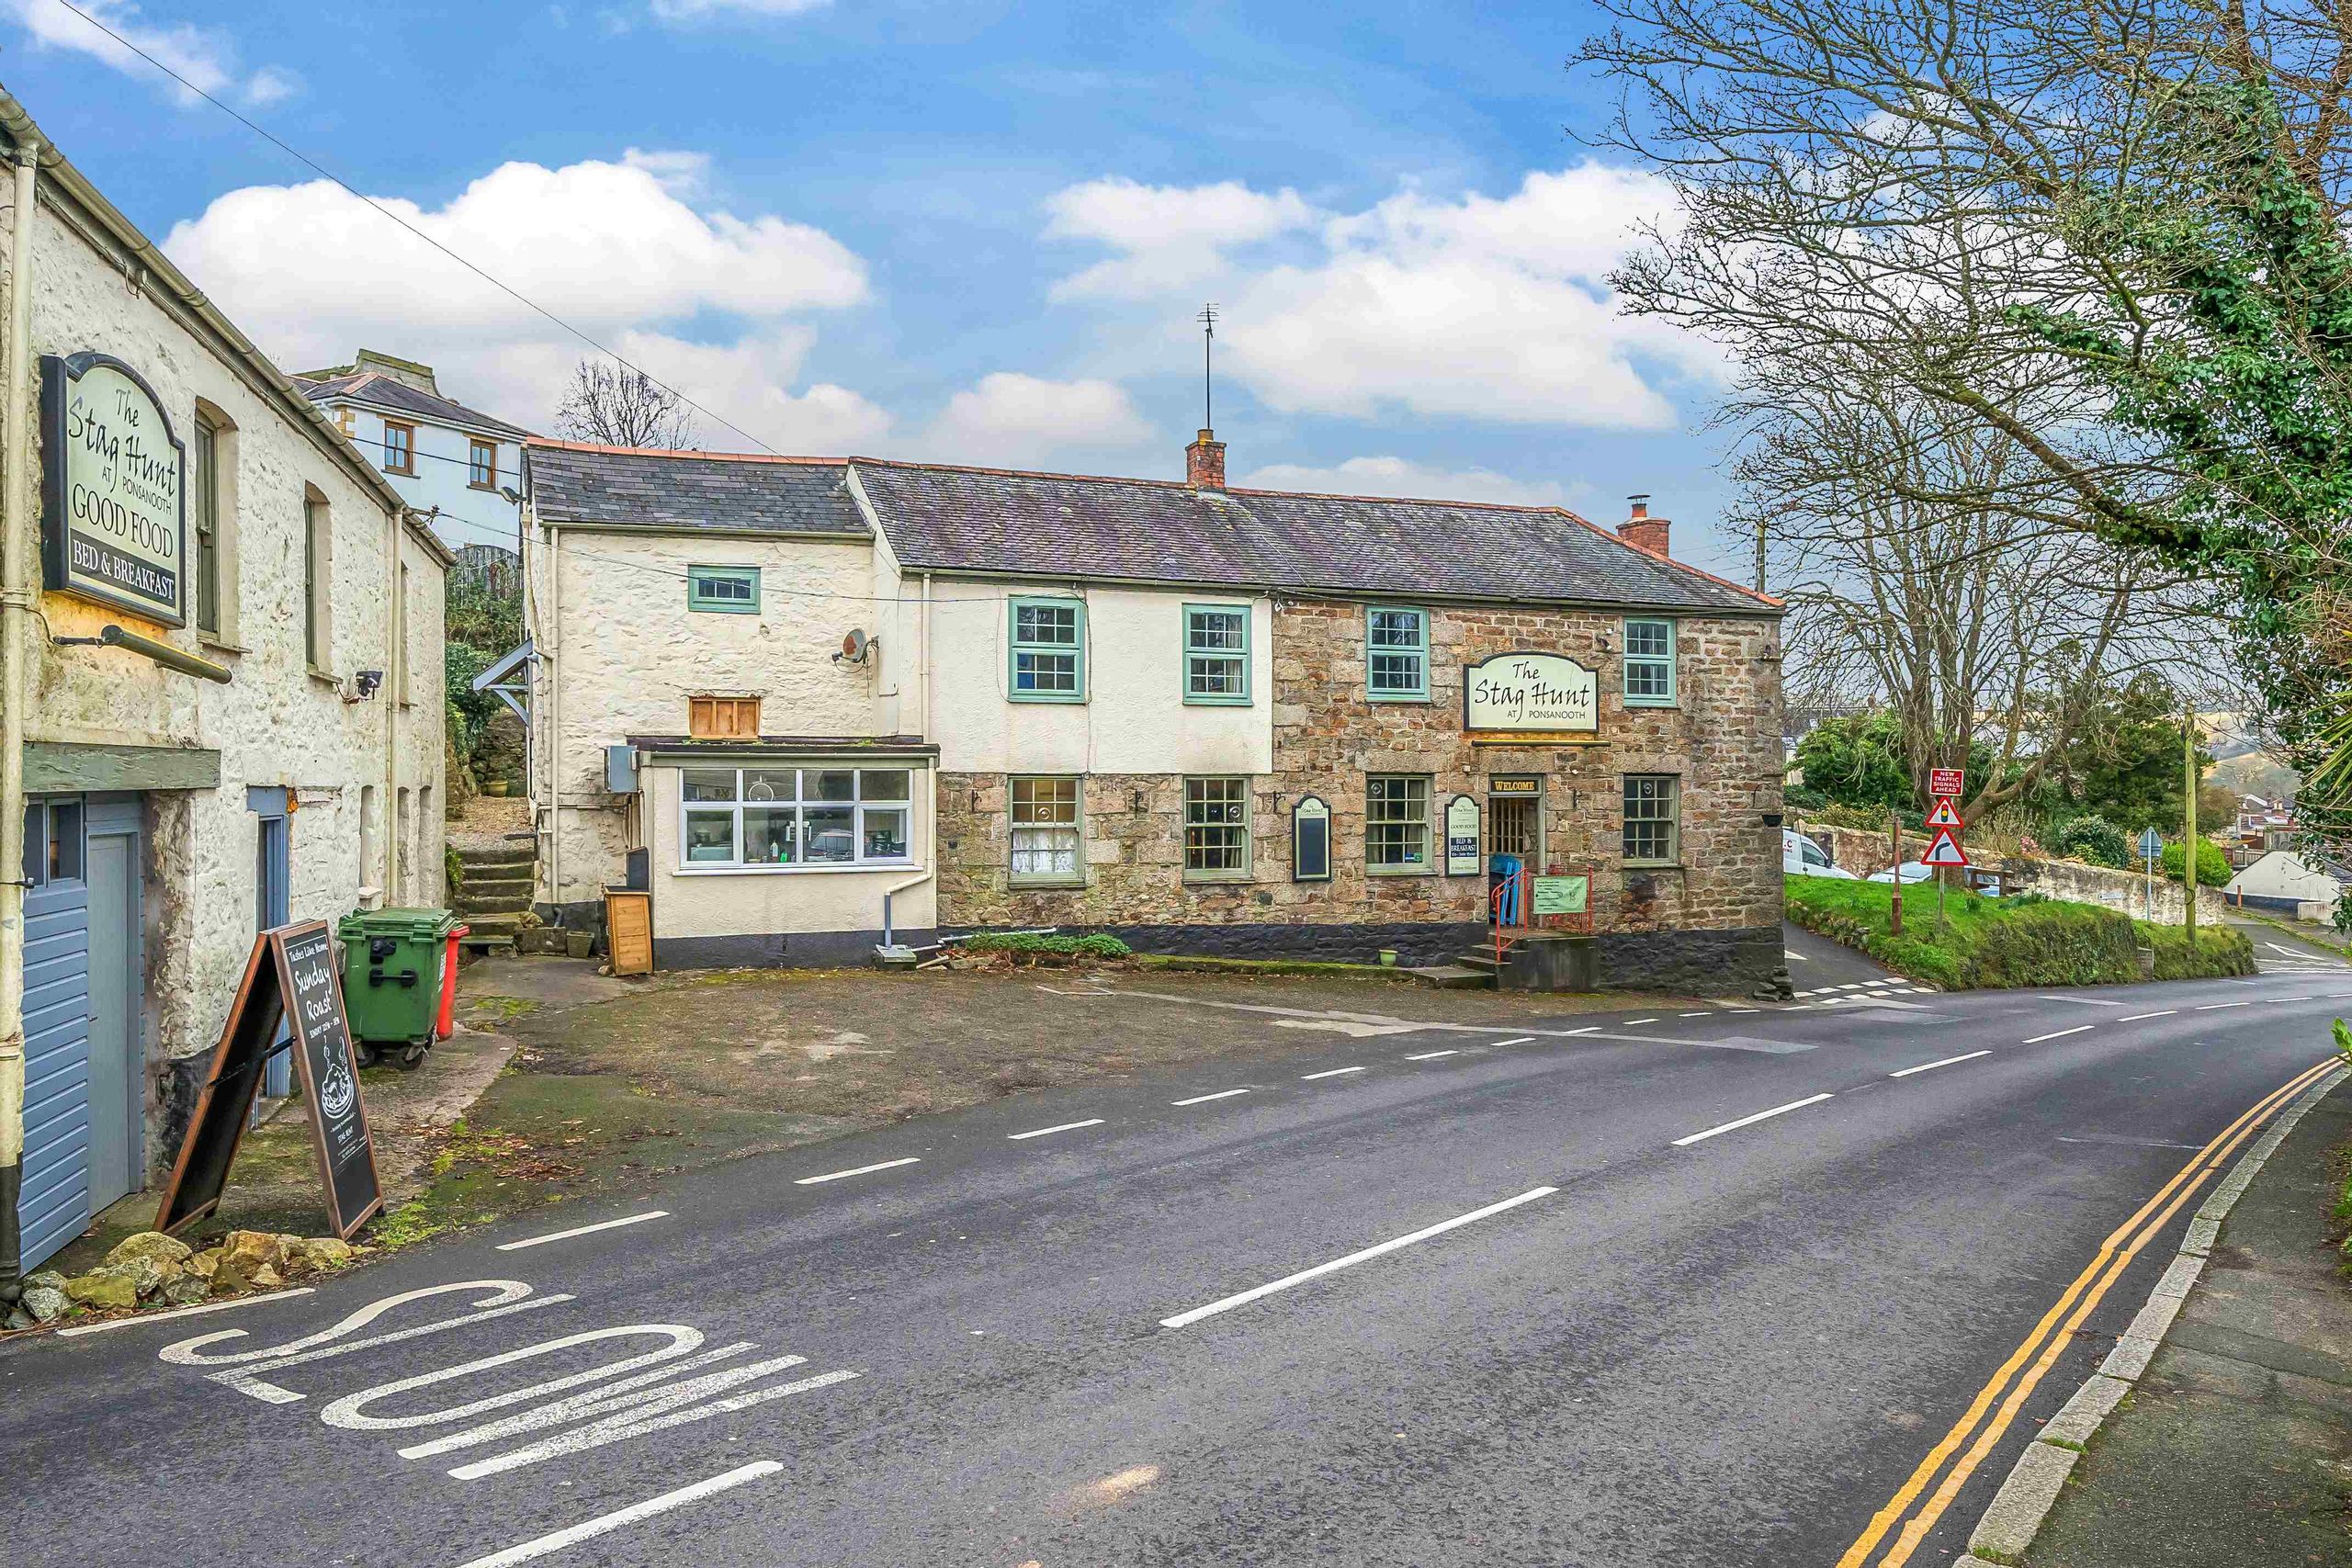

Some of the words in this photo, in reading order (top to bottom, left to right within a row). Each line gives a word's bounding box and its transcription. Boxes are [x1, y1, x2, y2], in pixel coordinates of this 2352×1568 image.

[116, 389, 140, 427] The
[69, 396, 119, 493] Stag
[126, 434, 176, 498] Hunt
[102, 465, 112, 483] AT
[122, 476, 172, 516] PONSANOOTH
[73, 483, 127, 536] GOOD
[130, 511, 174, 558] FOOD
[73, 539, 98, 571] BED
[101, 551, 112, 577] &
[113, 556, 175, 600] BREAKFAST
[1512, 661, 1541, 680] The
[1475, 678, 1525, 724] Stag
[1532, 682, 1590, 708] Hunt
[1507, 710, 1518, 718] AT
[1529, 710, 1586, 719] PONSANOOTH
[1495, 781, 1535, 791] WELCOME
[295, 960, 332, 996] Sunday
[306, 990, 333, 1021] Roast
[158, 1279, 866, 1481] SLOW
